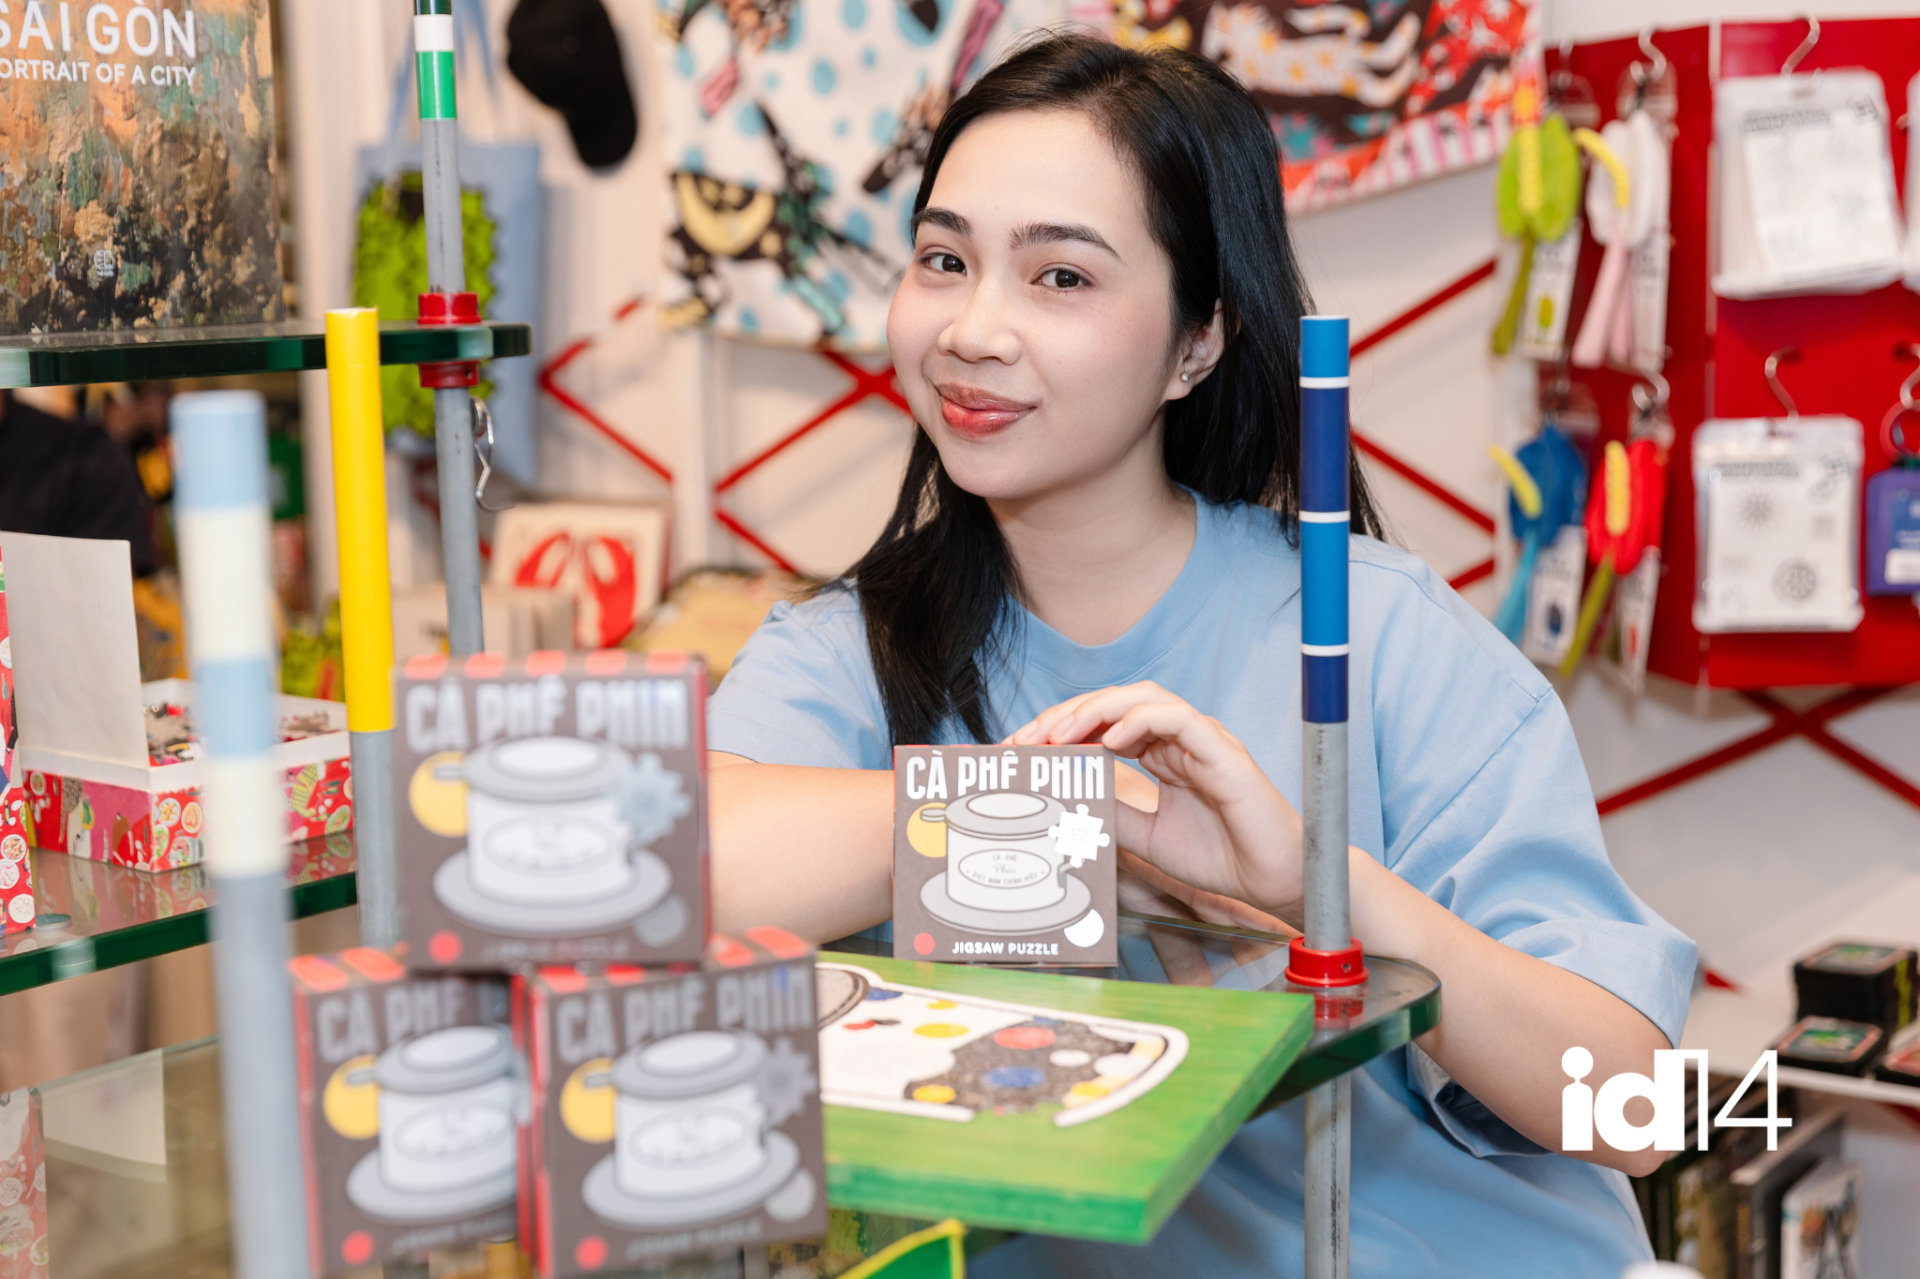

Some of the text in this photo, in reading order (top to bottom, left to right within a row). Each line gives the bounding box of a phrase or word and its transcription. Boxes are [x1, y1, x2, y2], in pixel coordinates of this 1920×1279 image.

[87, 0, 196, 58] GÒN
[96, 62, 126, 84] OF
[131, 64, 147, 86] A
[150, 65, 197, 87] CITY
[906, 749, 1105, 800] CÀ PHÊ PHIN
[952, 941, 1059, 955] JIGSAW PUZZLE
